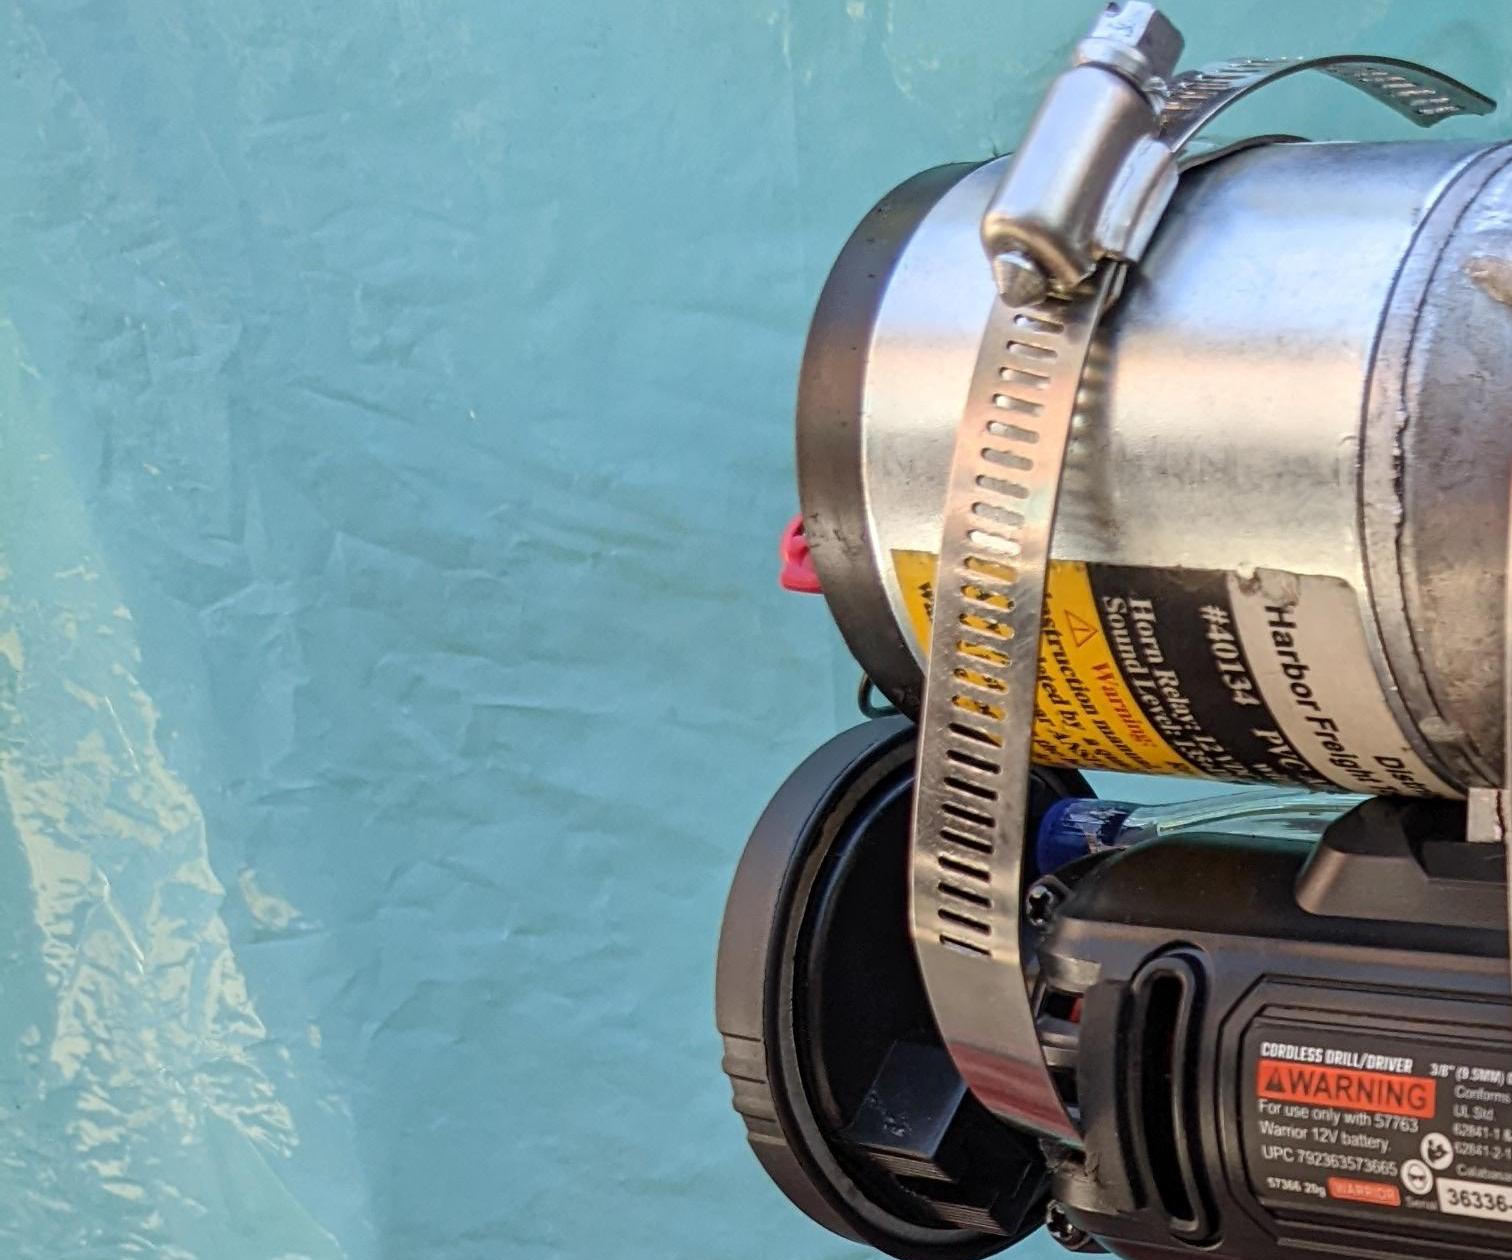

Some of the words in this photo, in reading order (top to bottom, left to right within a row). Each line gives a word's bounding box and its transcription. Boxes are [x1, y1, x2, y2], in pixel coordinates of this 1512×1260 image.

[1102, 595, 1149, 674] Sound
[1133, 680, 1181, 736] Level:
[1128, 597, 1164, 664] Horn
[1153, 668, 1201, 731] Relay:
[1200, 604, 1261, 706] #40134
[1091, 662, 1158, 747] Warning:
[1265, 601, 1321, 711] Harbor
[1306, 716, 1382, 784] Freight
[1057, 710, 1087, 730] by
[1261, 1041, 1323, 1062] CORDLESS
[1325, 1049, 1413, 1074] DRILL/DRIVER
[1288, 1068, 1427, 1110] WARNING
[1454, 1084, 1511, 1104] Conforms
[1258, 1098, 1281, 1113] For
[1284, 1104, 1309, 1119] use
[1312, 1108, 1341, 1126] only
[1343, 1112, 1371, 1126] with
[1374, 1114, 1419, 1133] 57763
[1453, 1104, 1469, 1118] UL
[1260, 1120, 1308, 1139] Warrior
[1312, 1127, 1339, 1143] 12V
[1340, 1131, 1392, 1154] battery.
[1261, 1145, 1295, 1162] UPC
[1297, 1149, 1399, 1177] 792363573665
